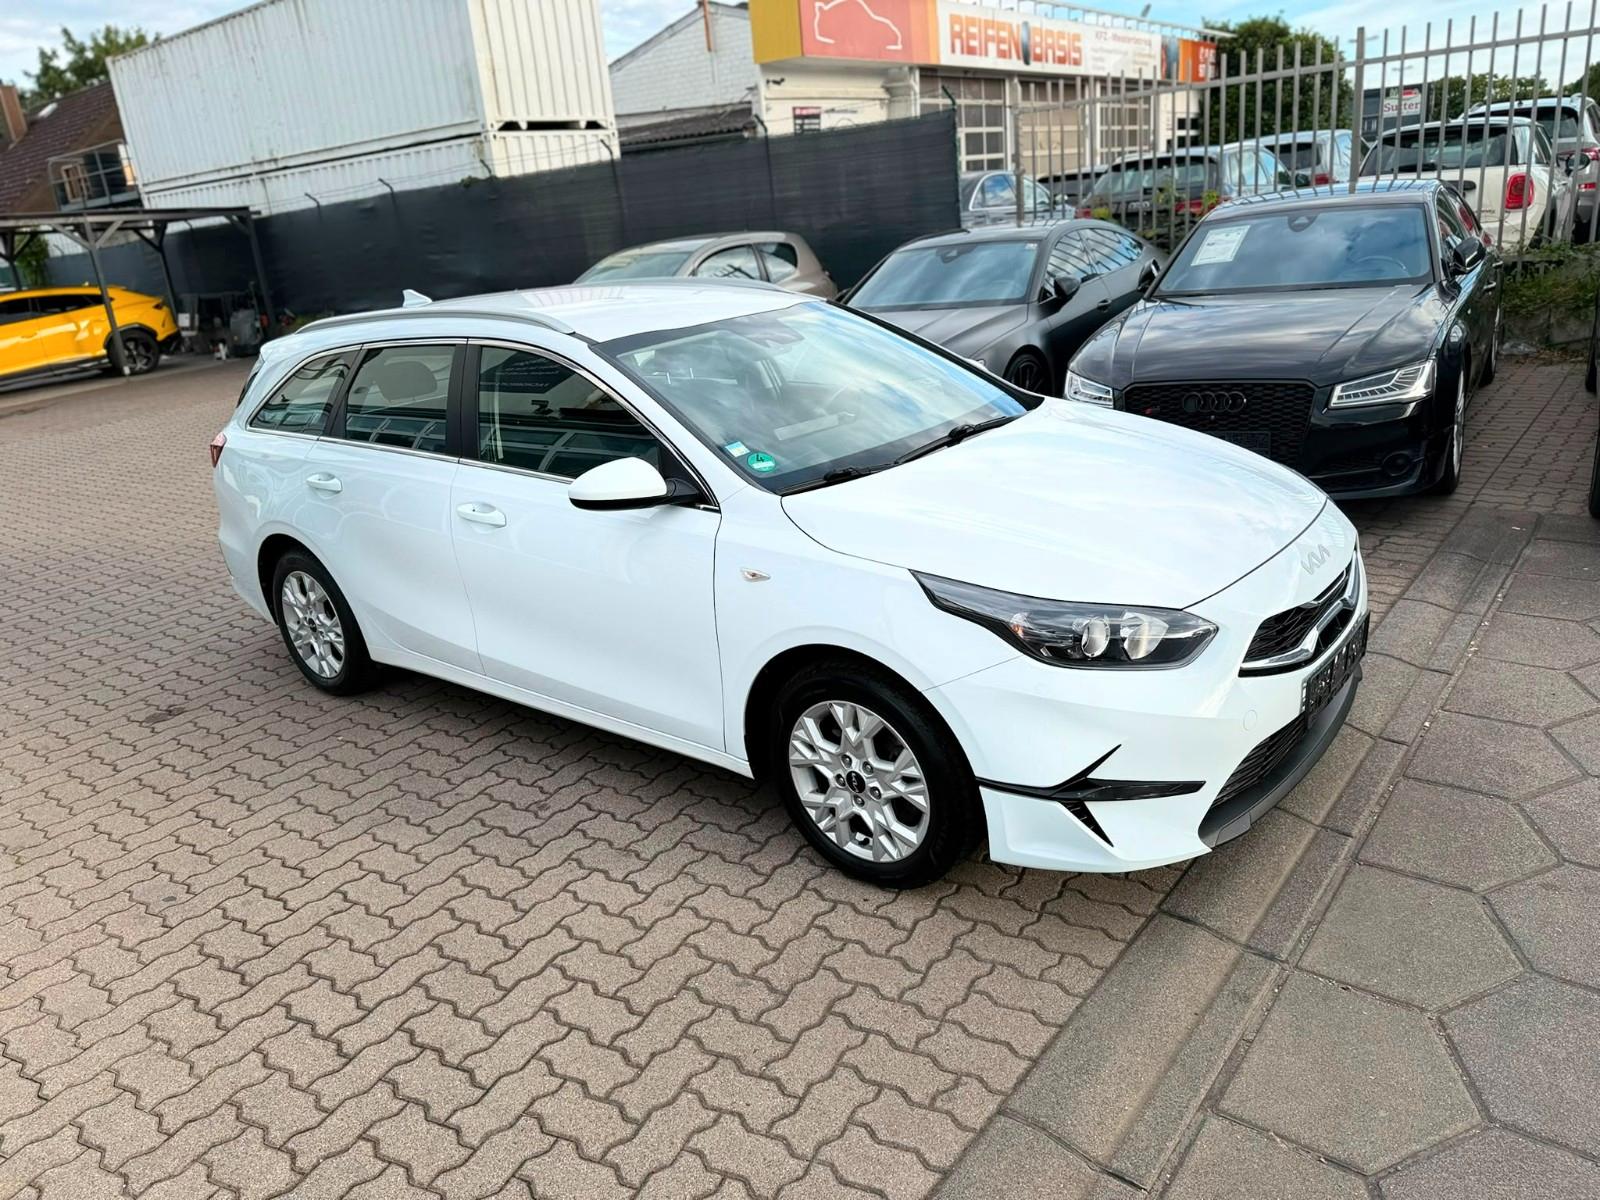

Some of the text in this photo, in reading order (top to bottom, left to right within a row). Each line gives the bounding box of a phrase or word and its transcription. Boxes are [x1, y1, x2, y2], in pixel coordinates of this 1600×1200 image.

[949, 14, 1082, 66] REIFEN BASIS
[1383, 102, 1420, 113] Suter
